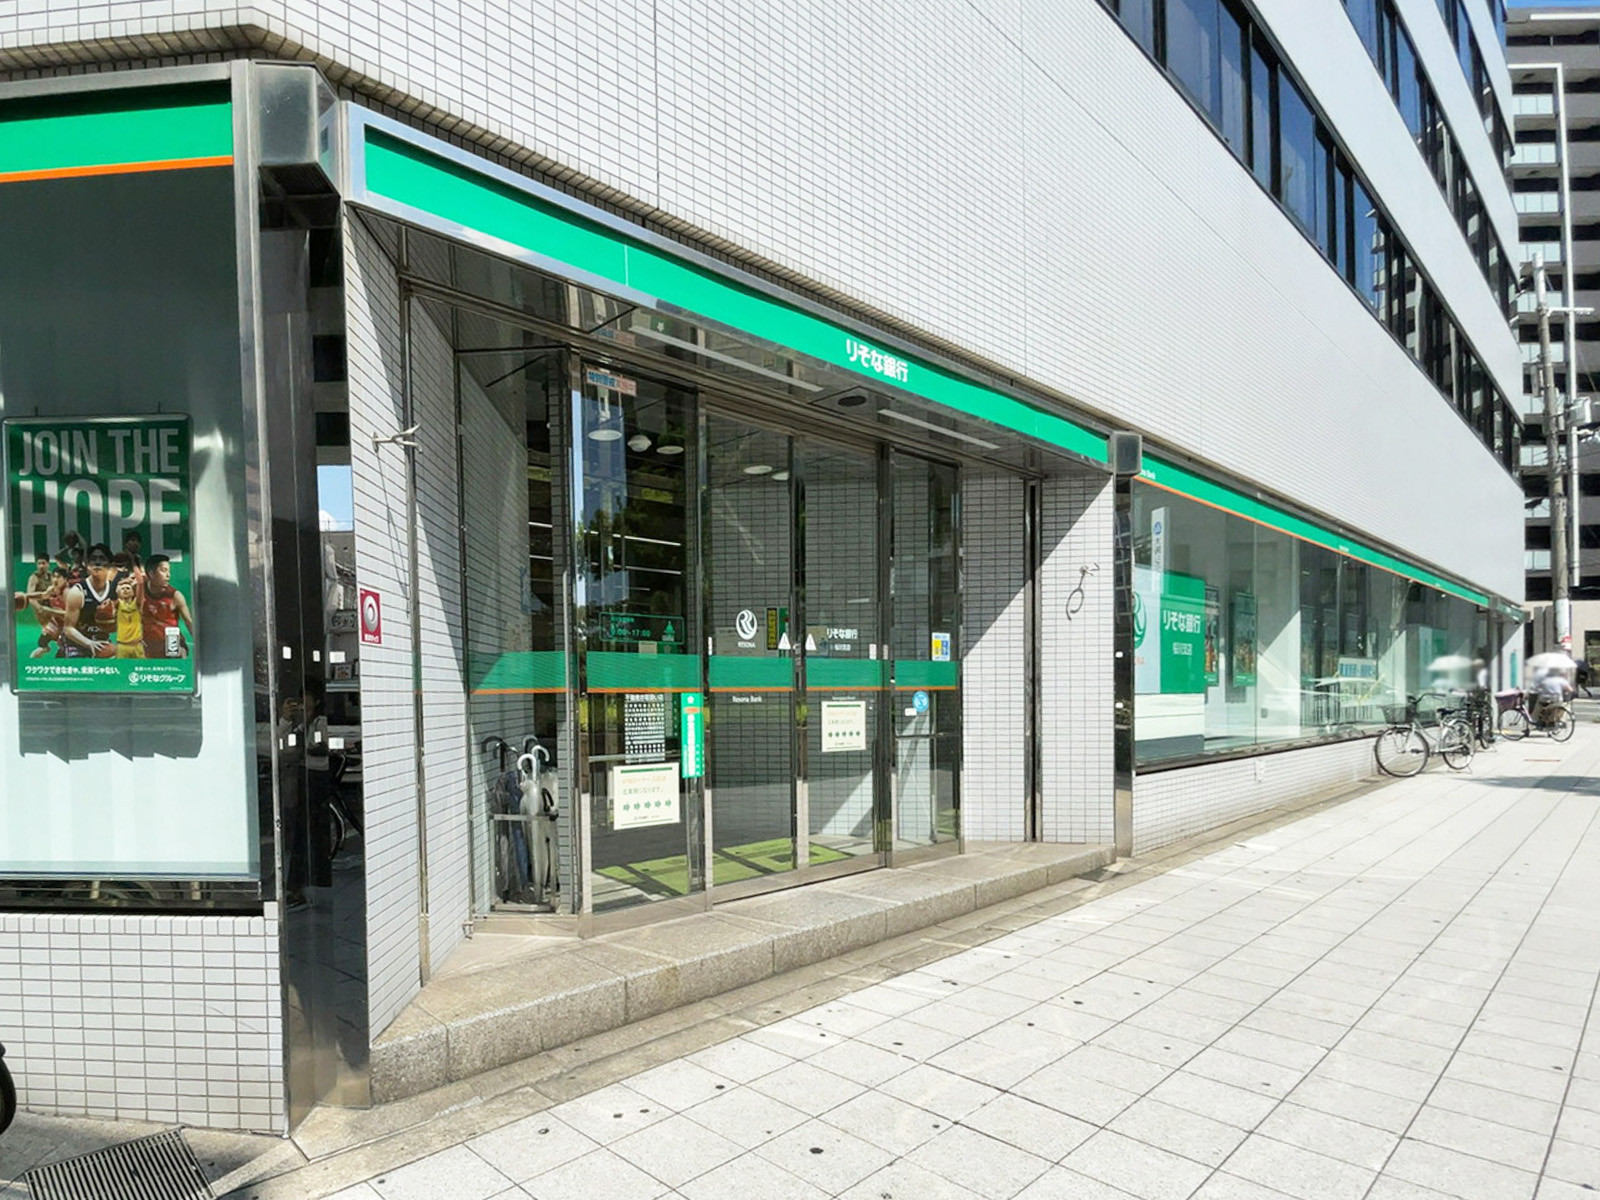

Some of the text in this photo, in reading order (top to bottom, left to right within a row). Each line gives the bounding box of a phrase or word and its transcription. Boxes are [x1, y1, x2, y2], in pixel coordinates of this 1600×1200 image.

[846, 338, 909, 383] りそな銀行
[19, 428, 180, 476] JOIN THE
[19, 478, 183, 563] HOPE
[827, 628, 858, 639] りそな銀行
[1163, 609, 1201, 634] りそな銀行
[139, 674, 187, 683] りそなグループ
